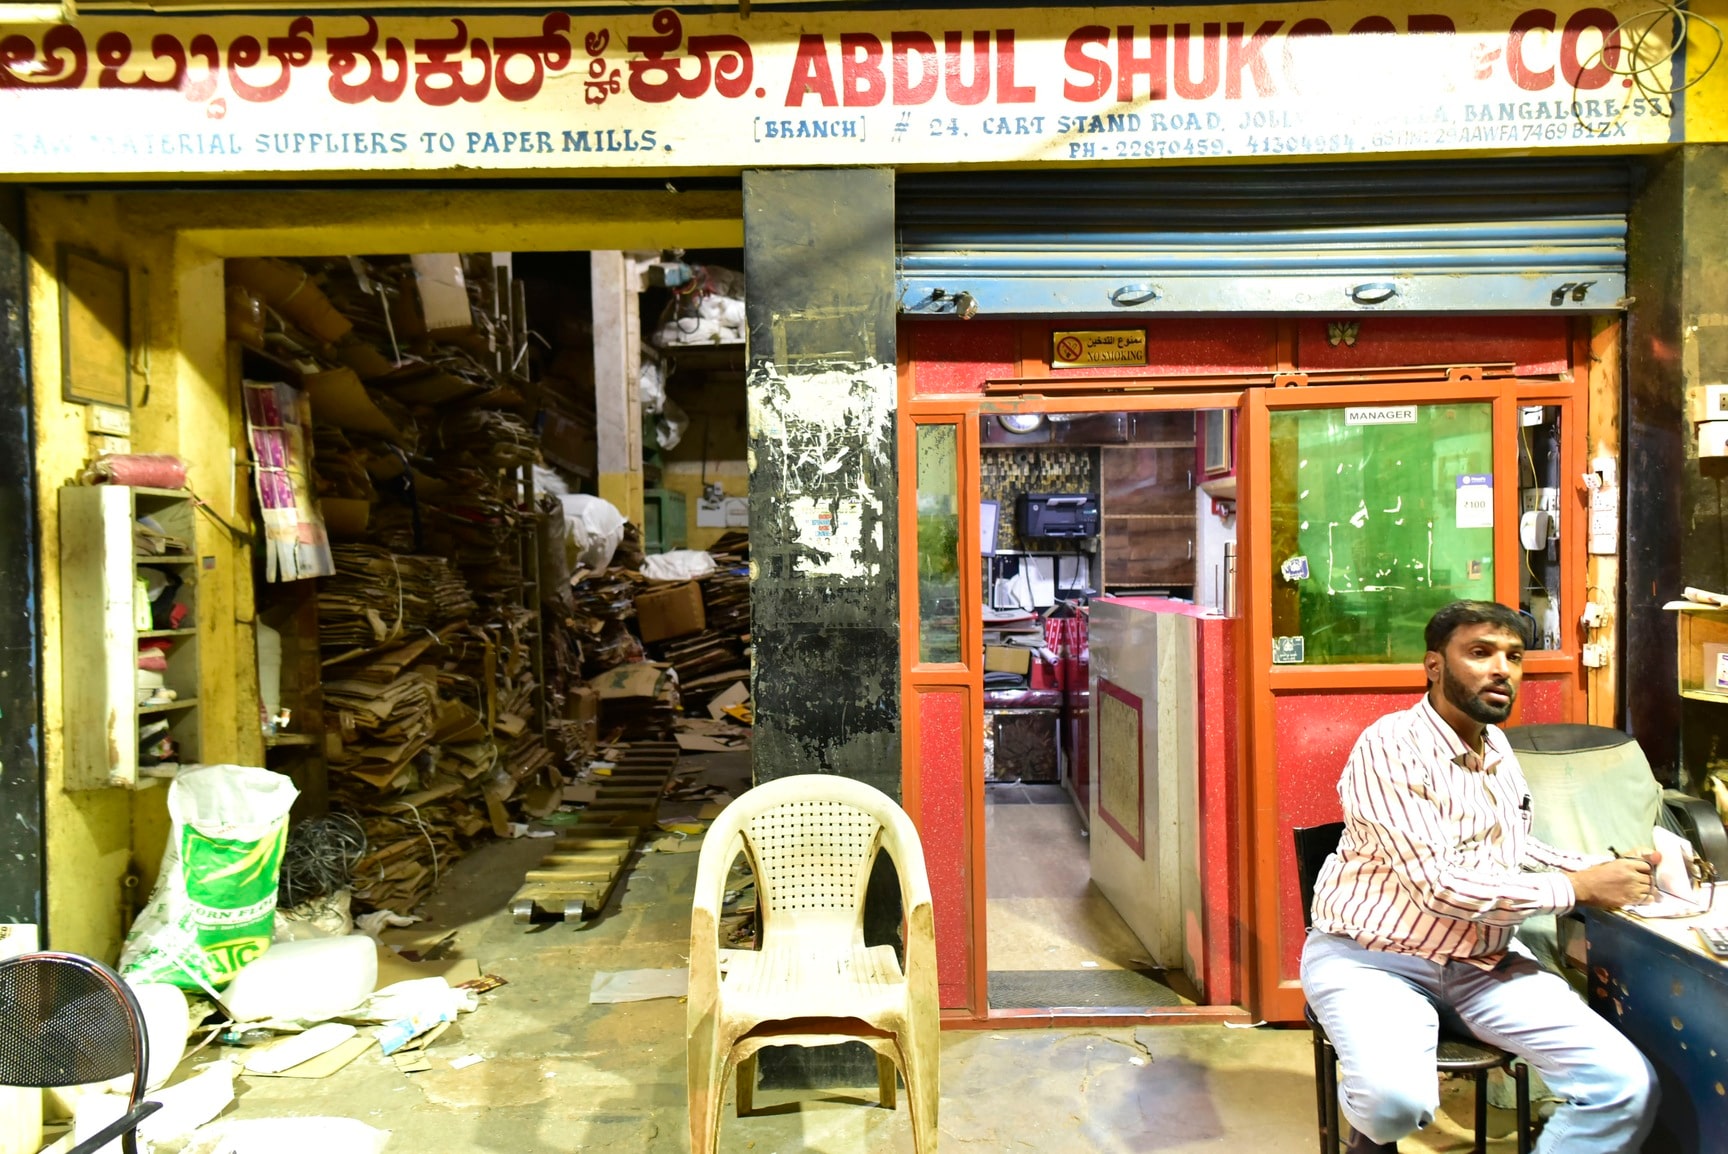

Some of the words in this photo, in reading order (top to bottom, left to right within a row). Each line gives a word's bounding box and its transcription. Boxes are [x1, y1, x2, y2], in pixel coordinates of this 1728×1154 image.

[784, 28, 1036, 107] ABDUL
[1505, 7, 1633, 91] CO.
[983, 116, 1045, 134] CART
[1057, 113, 1141, 133] STAND
[88, 132, 242, 155] ATERIAL
[254, 131, 408, 154] SUPPLIERS
[420, 131, 455, 153] TO
[466, 131, 555, 154] PAPER
[562, 129, 673, 153] MILLS.
[1087, 351, 1100, 362] NO
[1101, 350, 1143, 362] SMOKING
[1349, 410, 1412, 420] MANAGER
[188, 902, 232, 919] ORN
